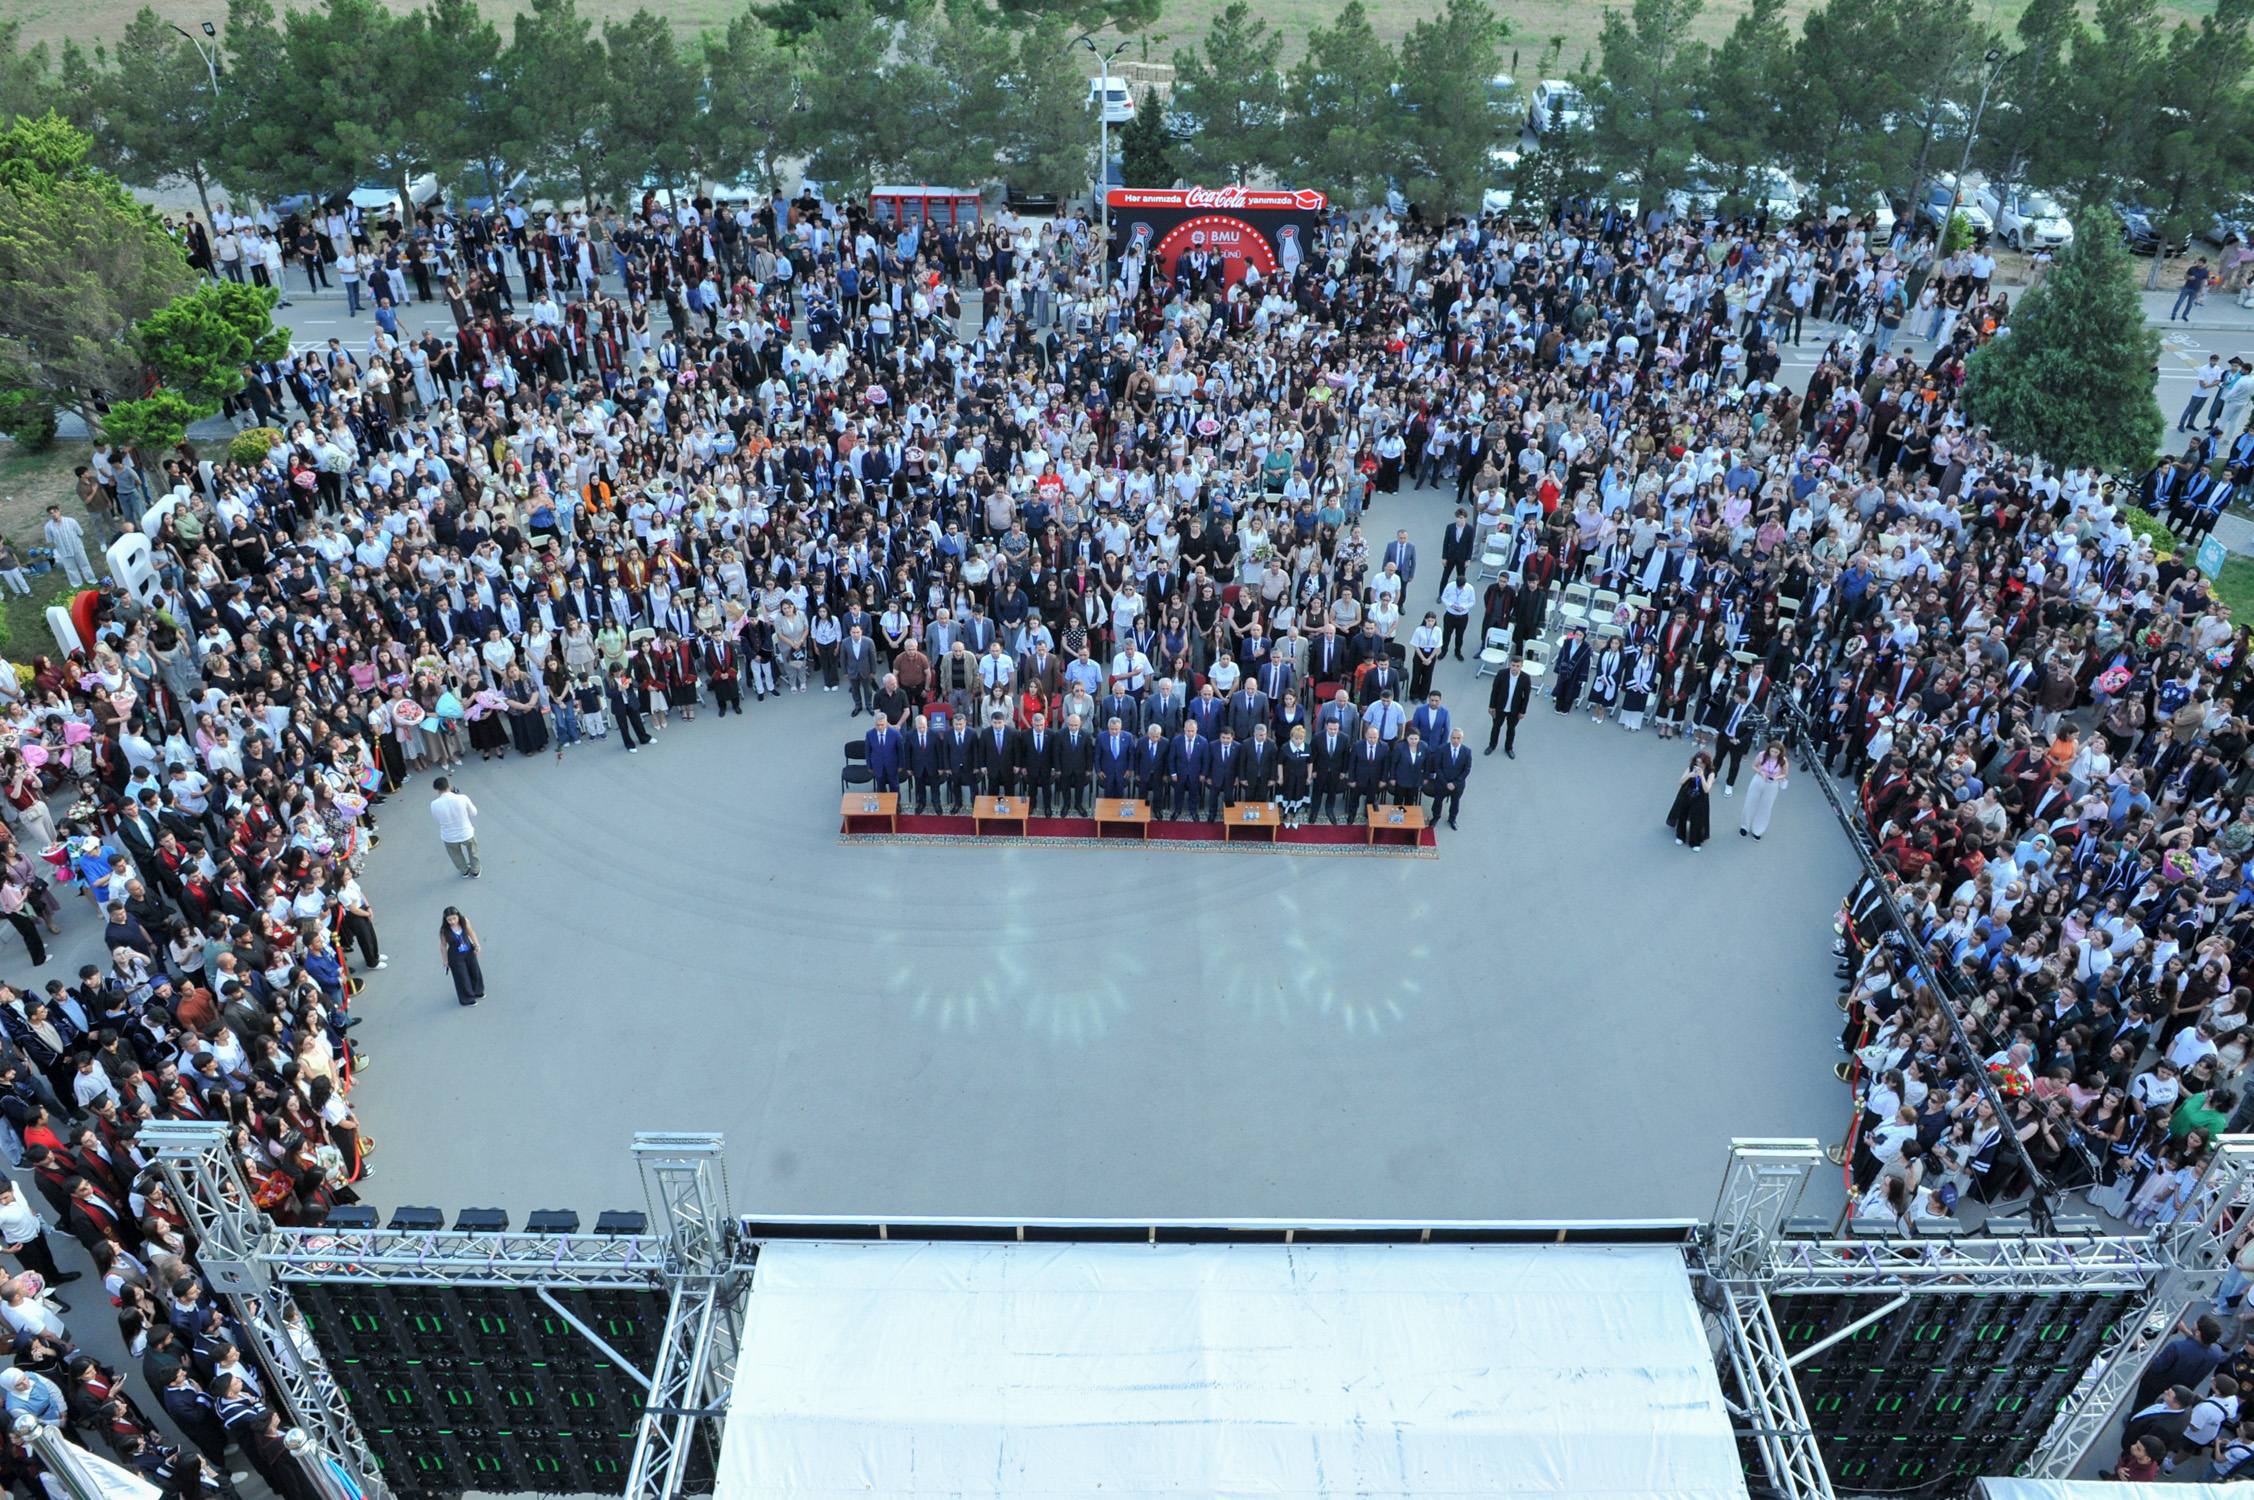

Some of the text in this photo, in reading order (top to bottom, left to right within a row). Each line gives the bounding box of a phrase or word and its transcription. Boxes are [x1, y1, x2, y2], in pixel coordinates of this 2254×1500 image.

[1125, 186, 1292, 208] Hər anımızda Coca-Cola yanımızda
[1211, 231, 1240, 242] BMU
